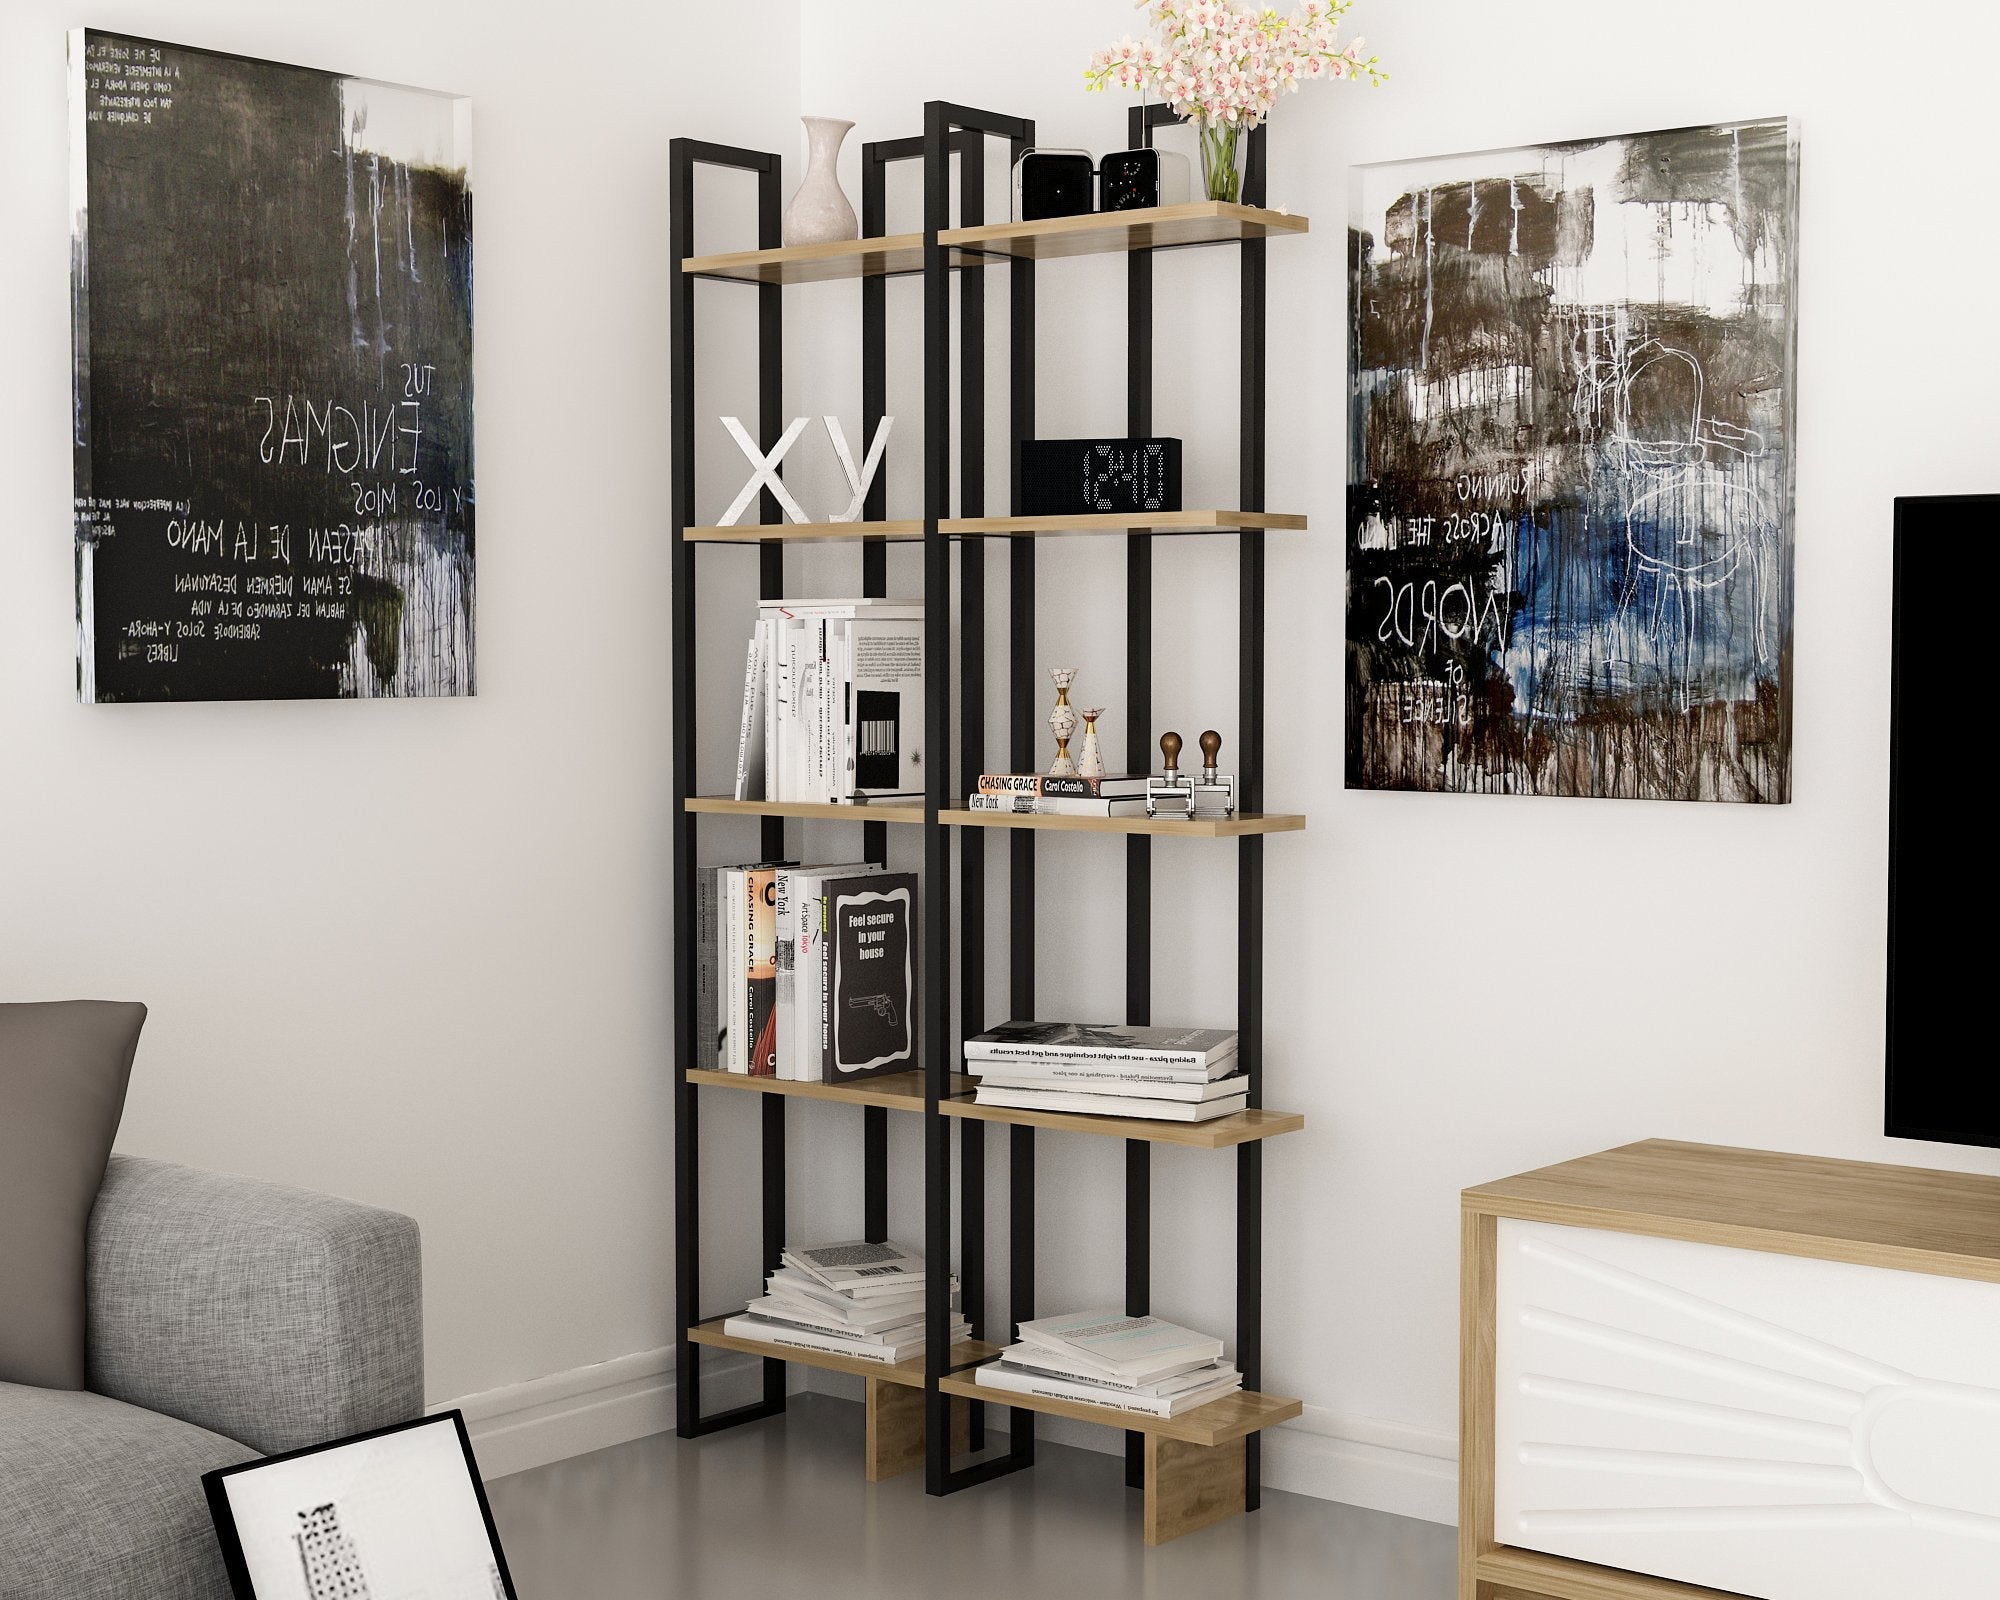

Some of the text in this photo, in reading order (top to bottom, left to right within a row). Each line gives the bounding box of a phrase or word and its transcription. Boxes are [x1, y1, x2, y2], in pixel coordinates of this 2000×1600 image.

[980, 776, 1037, 791] CHASING GRACE
[1044, 780, 1060, 792] Carol
[1061, 780, 1084, 793] Costello
[971, 794, 998, 809] New York
[777, 875, 789, 916] New York
[848, 912, 894, 928] Feel secure
[801, 902, 810, 954] Art Space Tokyo
[858, 929, 886, 945] in your
[859, 947, 884, 960] house
[822, 992, 829, 1001] in
